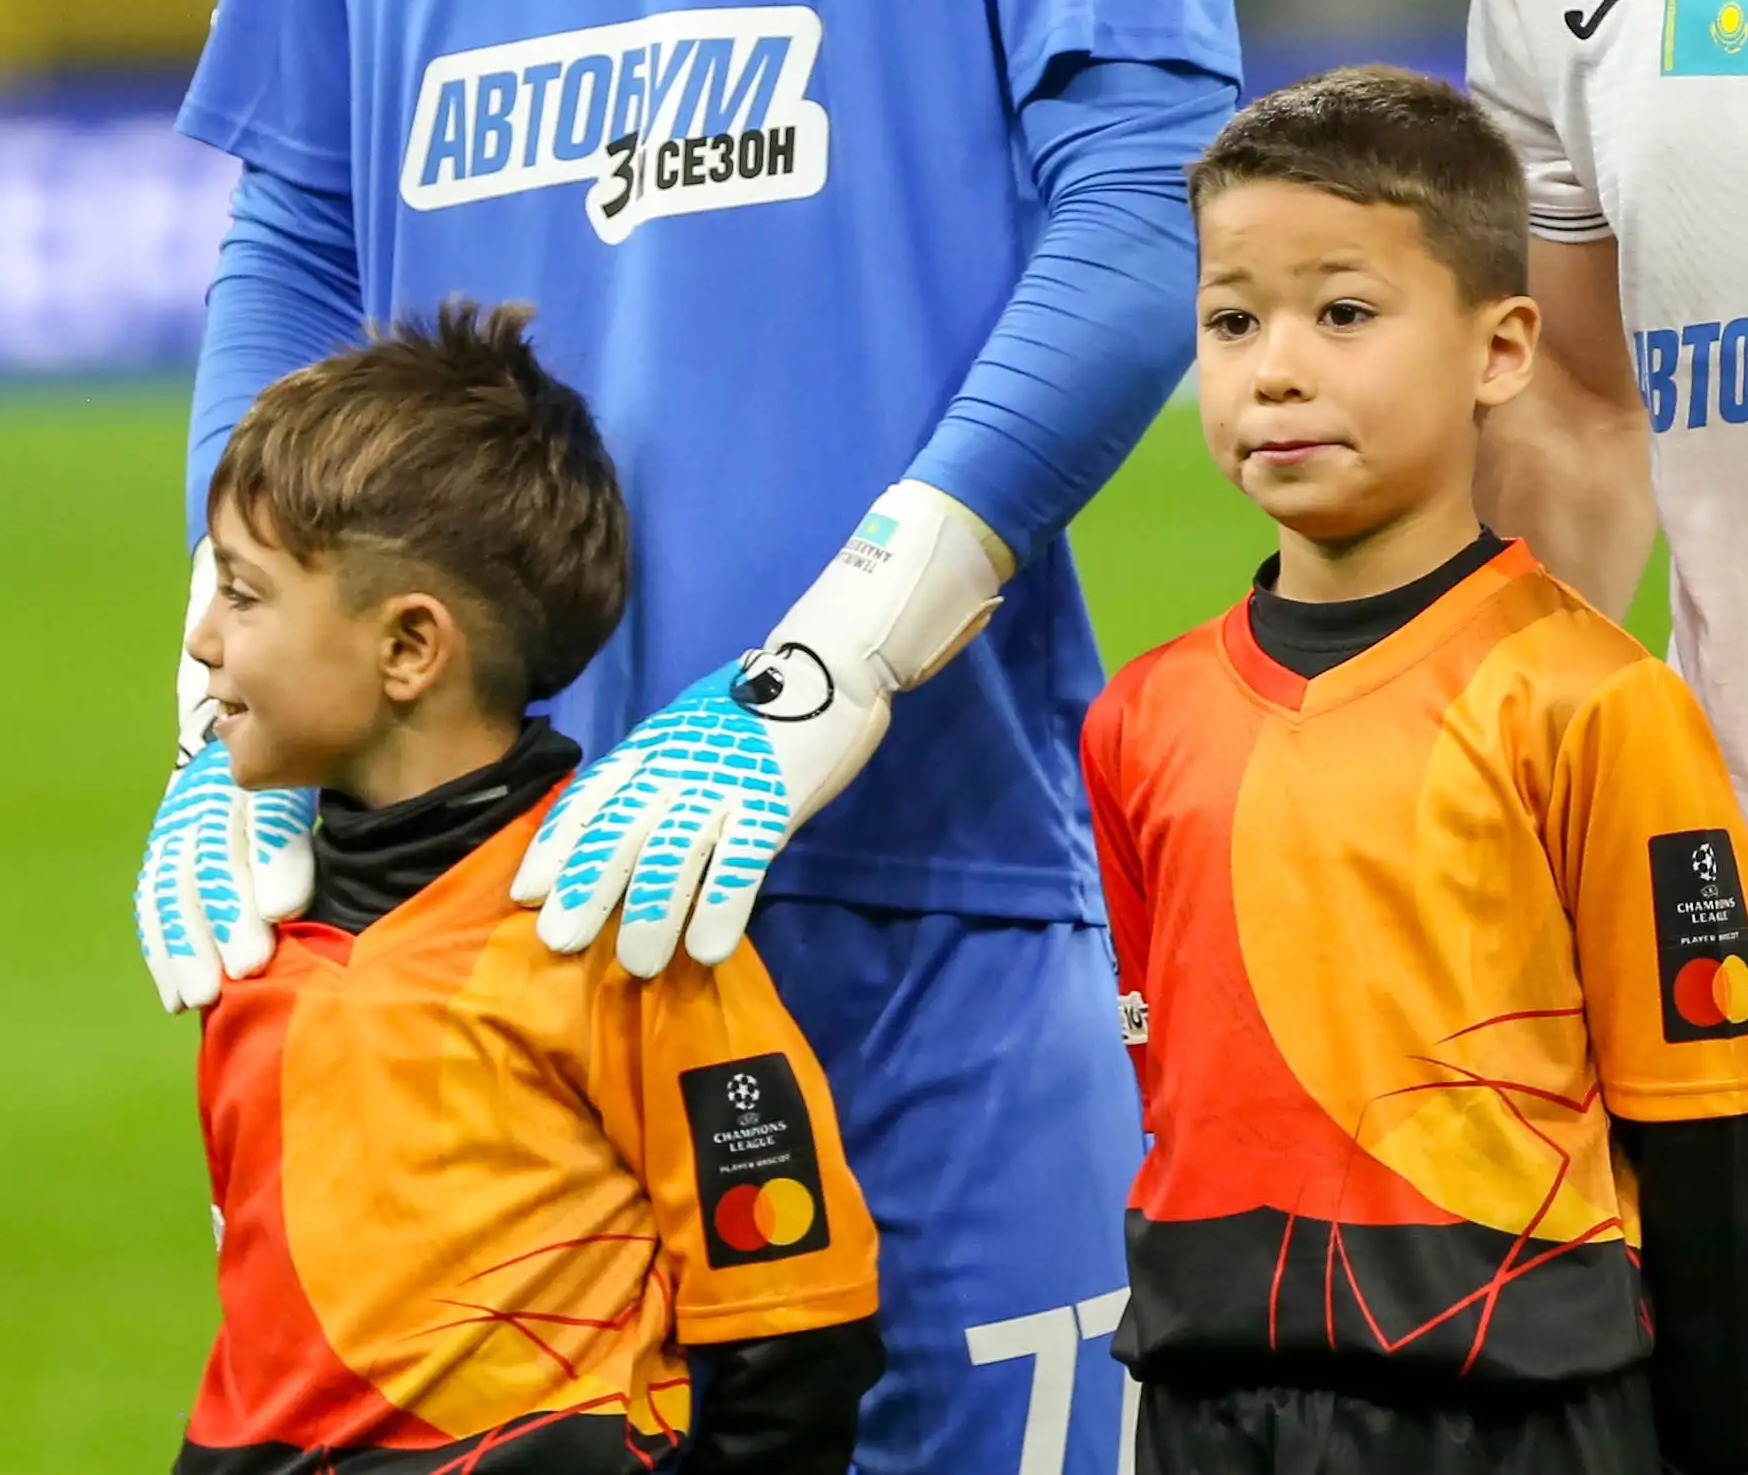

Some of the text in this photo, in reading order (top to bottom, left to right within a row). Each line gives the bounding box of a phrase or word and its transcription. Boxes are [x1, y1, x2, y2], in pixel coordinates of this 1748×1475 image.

[419, 36, 793, 187] АВТОБУМ
[656, 126, 796, 190] СЕЗОН
[713, 1120, 788, 1144] CHAMPIONS
